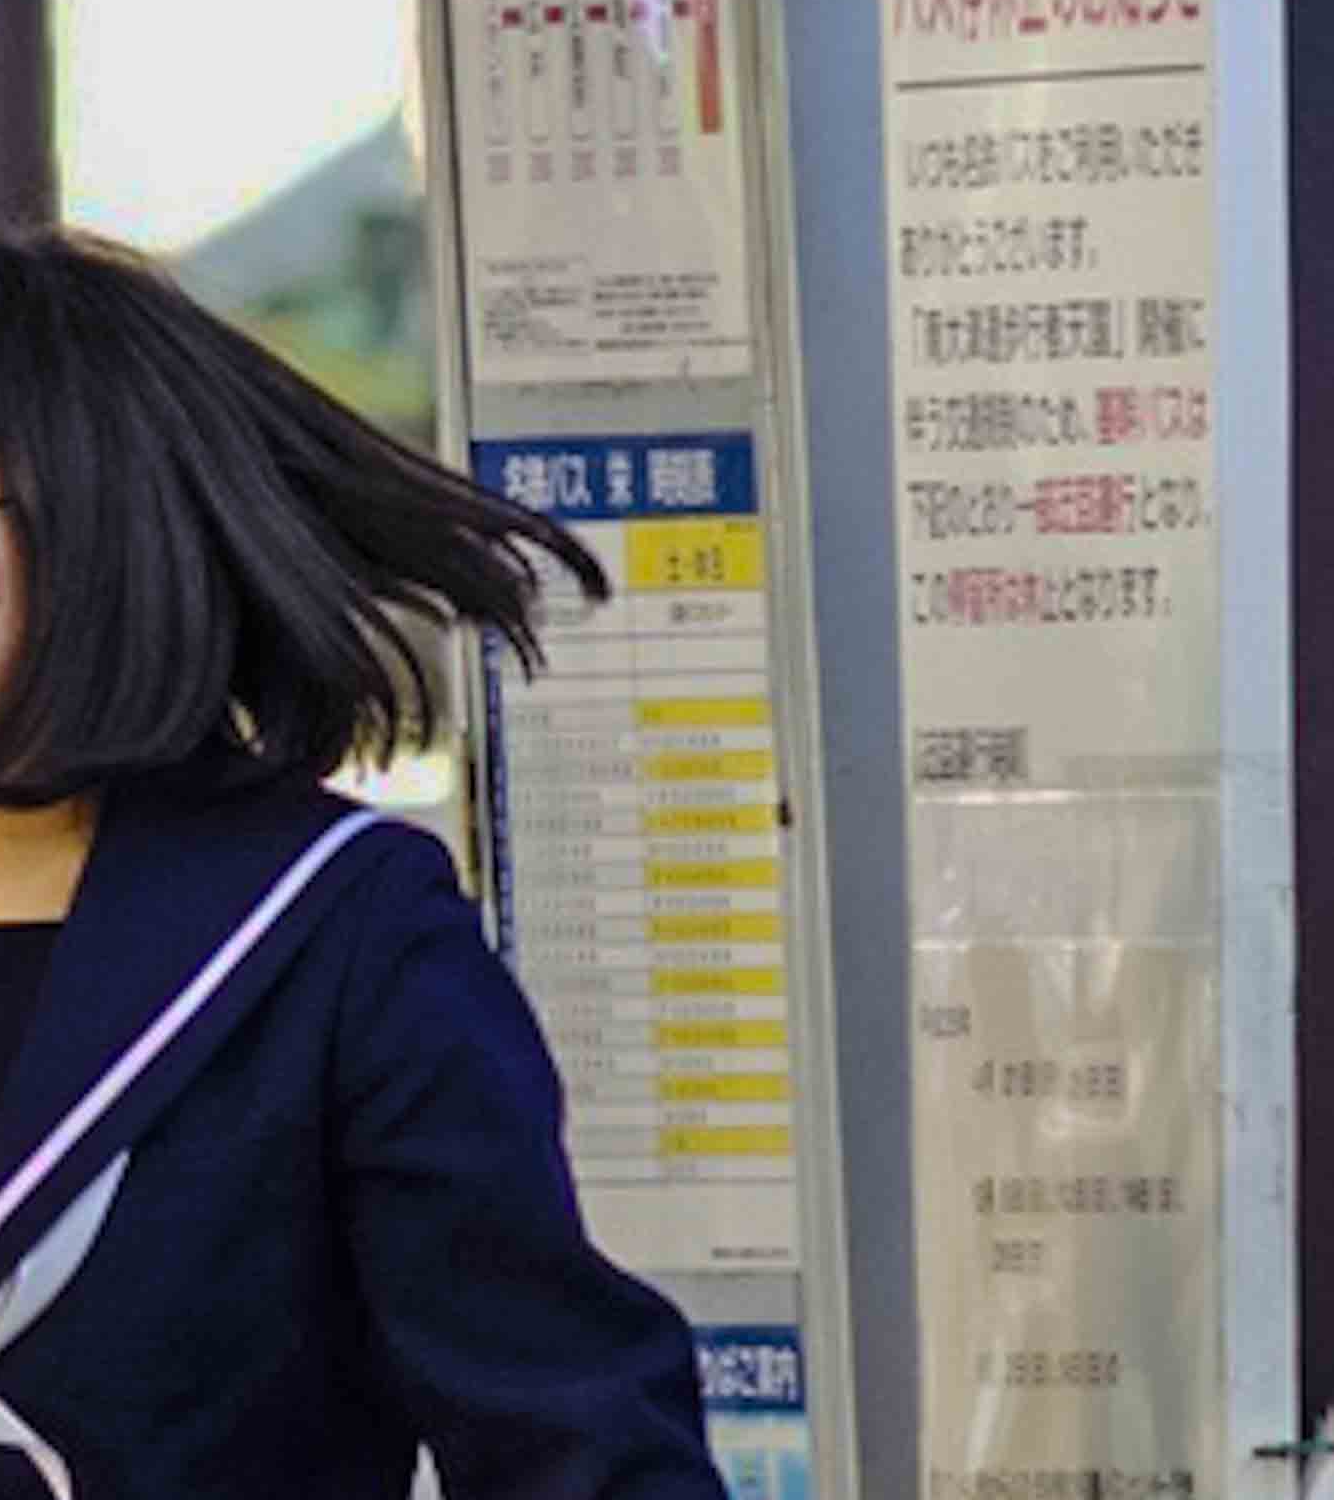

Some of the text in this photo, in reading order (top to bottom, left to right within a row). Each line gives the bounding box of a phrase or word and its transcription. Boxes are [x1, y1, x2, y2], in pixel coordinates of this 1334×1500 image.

[900, 217, 1101, 278] ありがとうございます。
